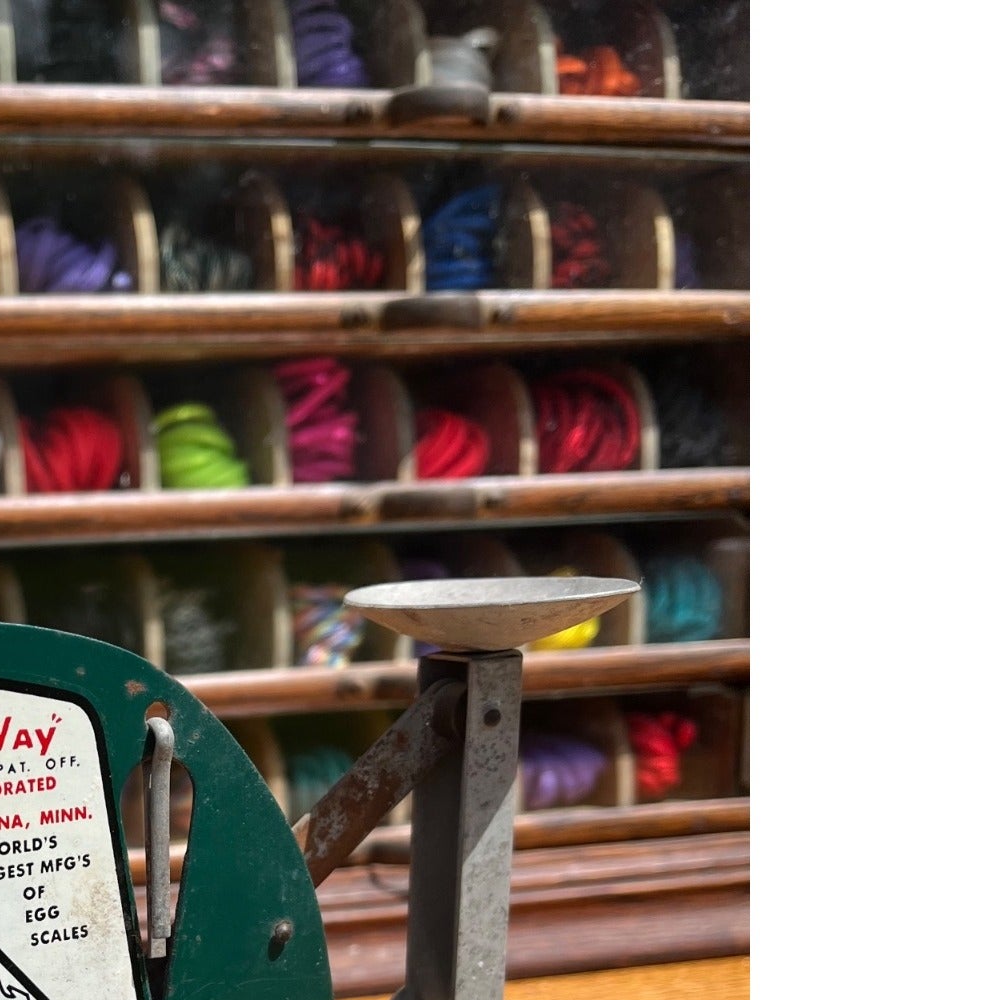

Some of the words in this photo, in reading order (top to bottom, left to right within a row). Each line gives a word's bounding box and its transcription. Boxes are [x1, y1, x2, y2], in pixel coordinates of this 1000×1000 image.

[45, 755, 81, 770] OFF.
[40, 806, 93, 825] MINN.
[40, 854, 91, 874] MFG'S
[23, 885, 45, 900] OF
[25, 905, 60, 923] EGG
[30, 925, 89, 946] SCALES
